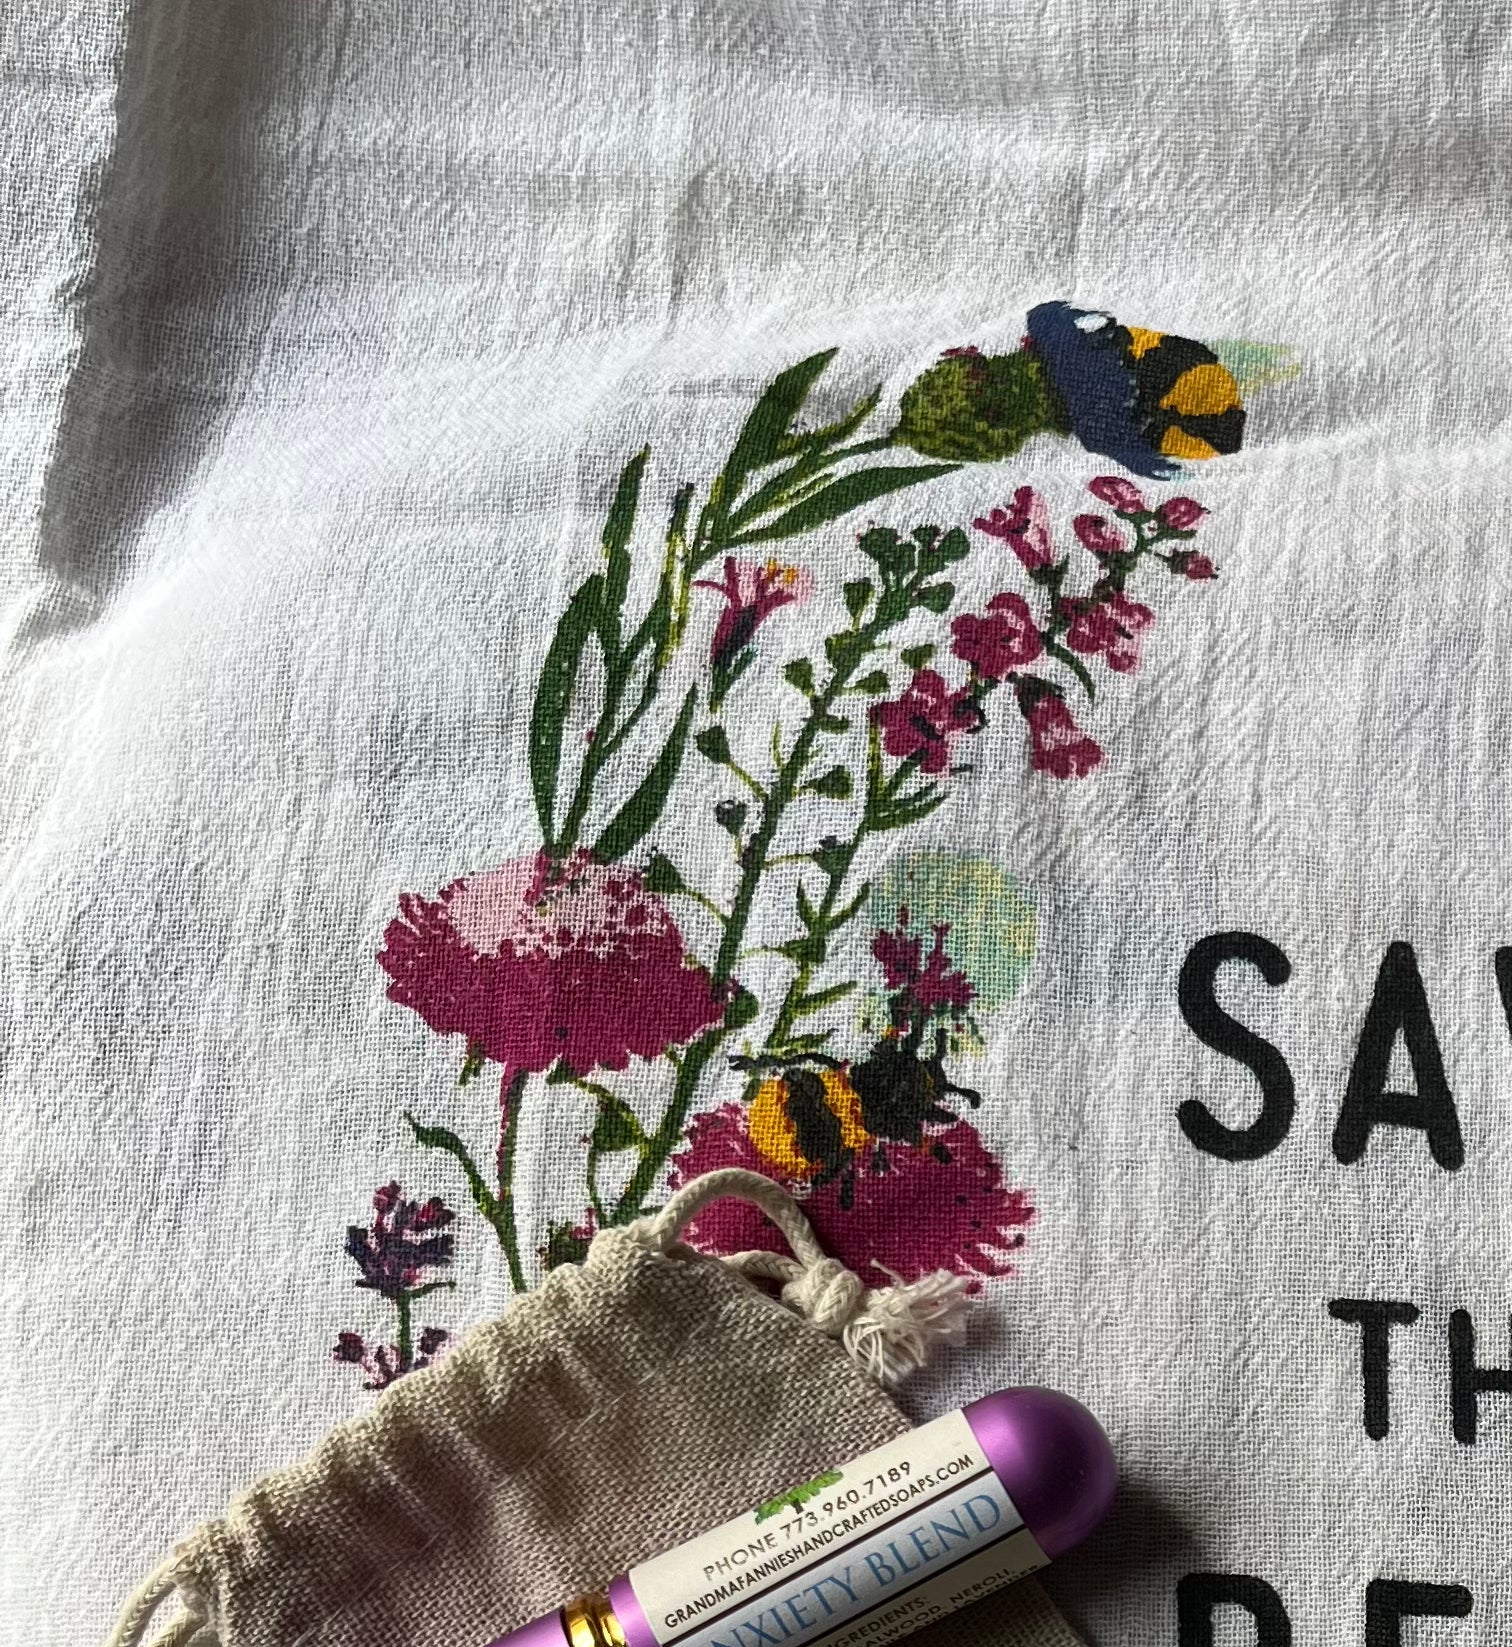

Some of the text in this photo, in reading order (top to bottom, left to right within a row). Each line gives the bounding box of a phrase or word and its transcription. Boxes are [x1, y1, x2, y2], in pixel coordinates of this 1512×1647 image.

[664, 1454, 974, 1629] GRANDMAFANNIESHANDCRAFTEDSOAPS.COM
[704, 1461, 912, 1582] PHONE 773.960.7189
[864, 1493, 1001, 1588] BLEND
